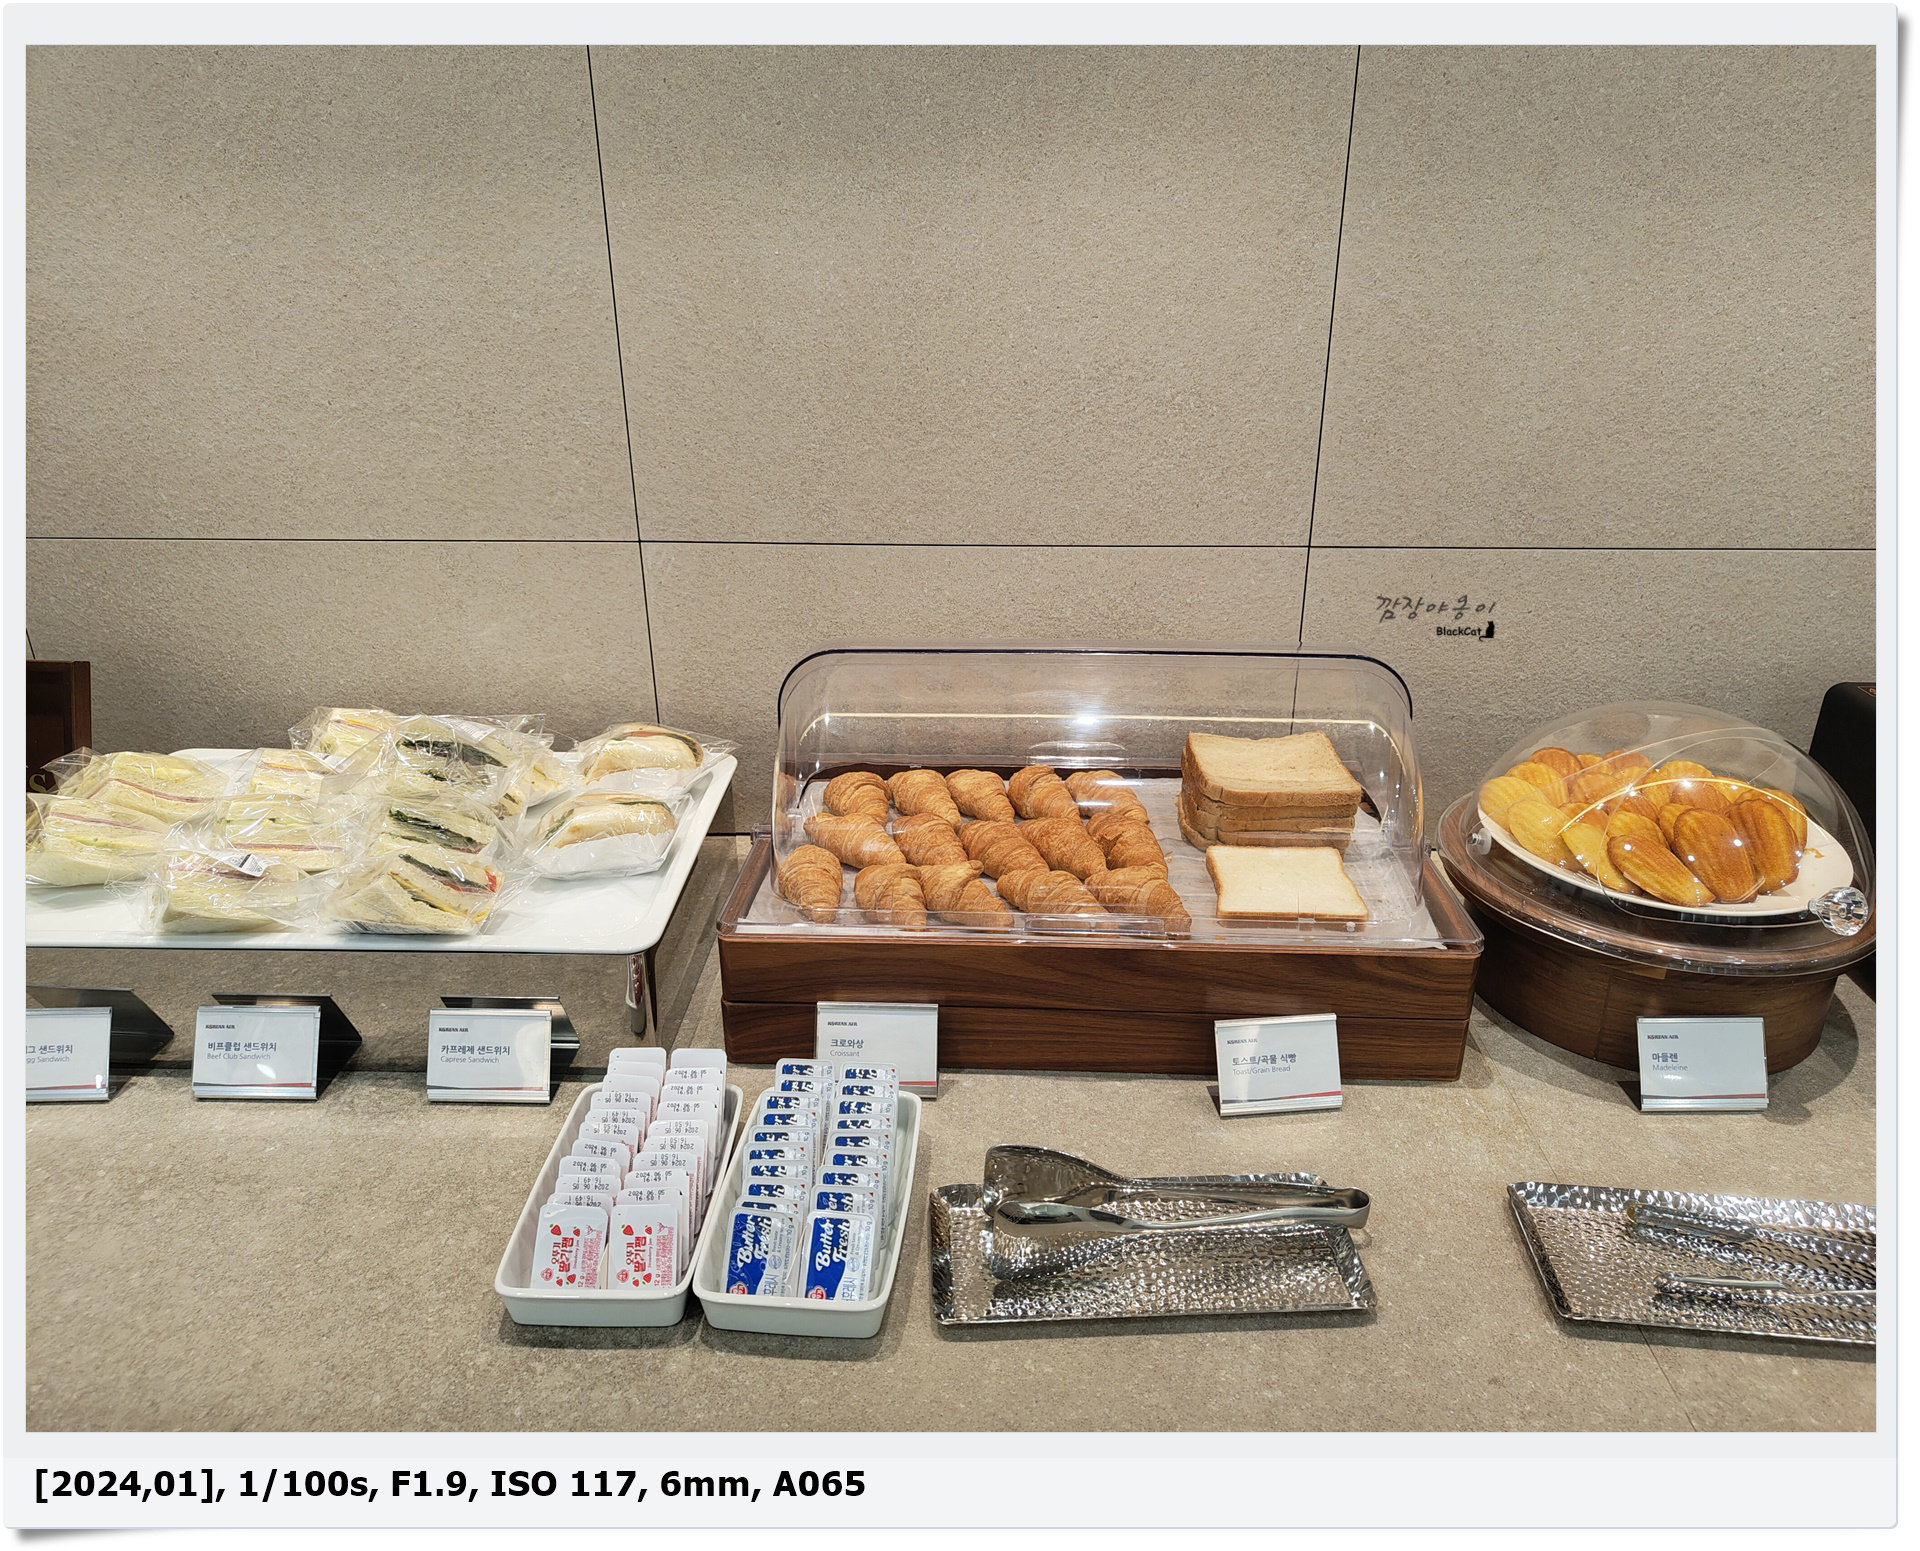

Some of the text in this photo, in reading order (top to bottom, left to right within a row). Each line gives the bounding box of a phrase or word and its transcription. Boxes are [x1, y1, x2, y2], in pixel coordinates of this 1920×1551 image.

[39, 1044, 73, 1054] 샌드위치
[208, 1042, 277, 1052] 비프클럽 샌드위치
[830, 1039, 864, 1049] 크로와상
[441, 1045, 511, 1055] 카프레제 샌드위치
[468, 1056, 500, 1064] Sandwich
[1232, 1053, 1297, 1066] 토스트/곡물 식빵
[1652, 1052, 1679, 1063] 마들렌
[1232, 1065, 1291, 1076] Toast/Grain Bread
[737, 1214, 756, 1268] Butter
[754, 1216, 772, 1260] Fresh
[832, 1221, 851, 1263] Fresh
[816, 1219, 834, 1271] Butter
